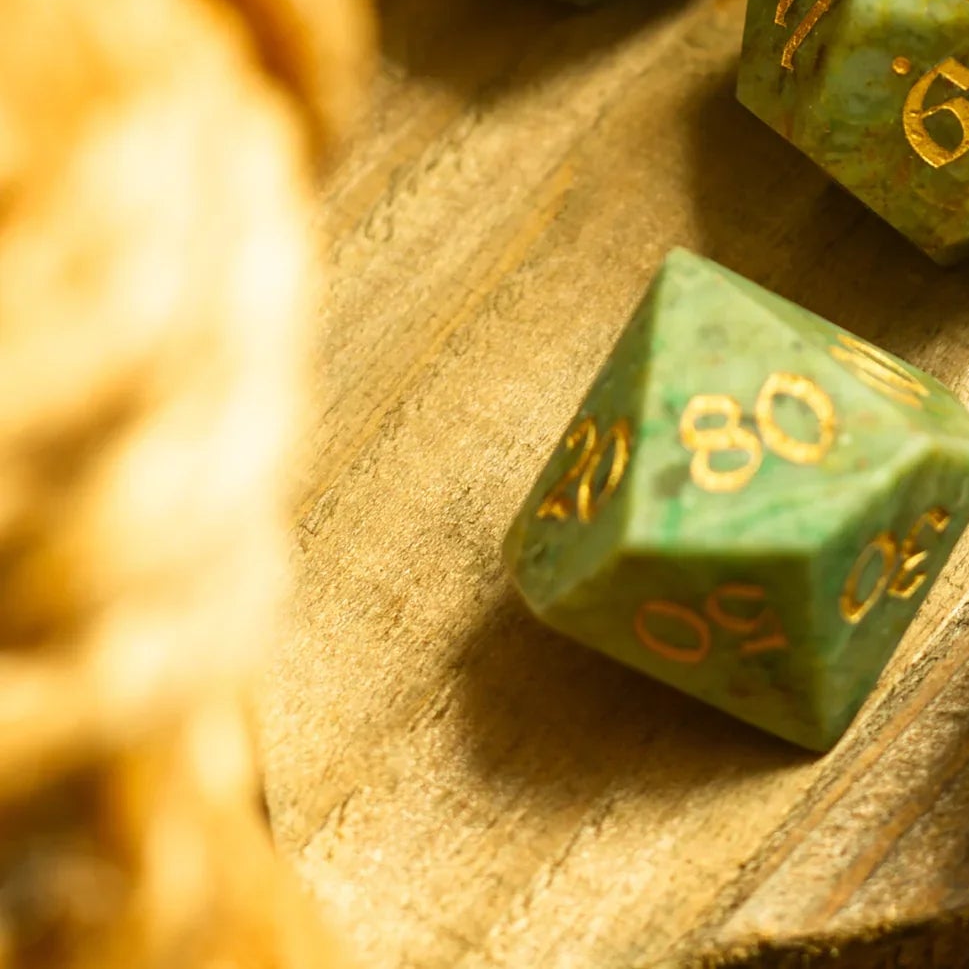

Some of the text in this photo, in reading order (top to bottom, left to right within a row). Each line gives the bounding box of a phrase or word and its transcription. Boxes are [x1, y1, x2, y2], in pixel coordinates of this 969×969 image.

[536, 417, 630, 523] 20
[680, 372, 835, 493] 80
[633, 582, 788, 663] 50
